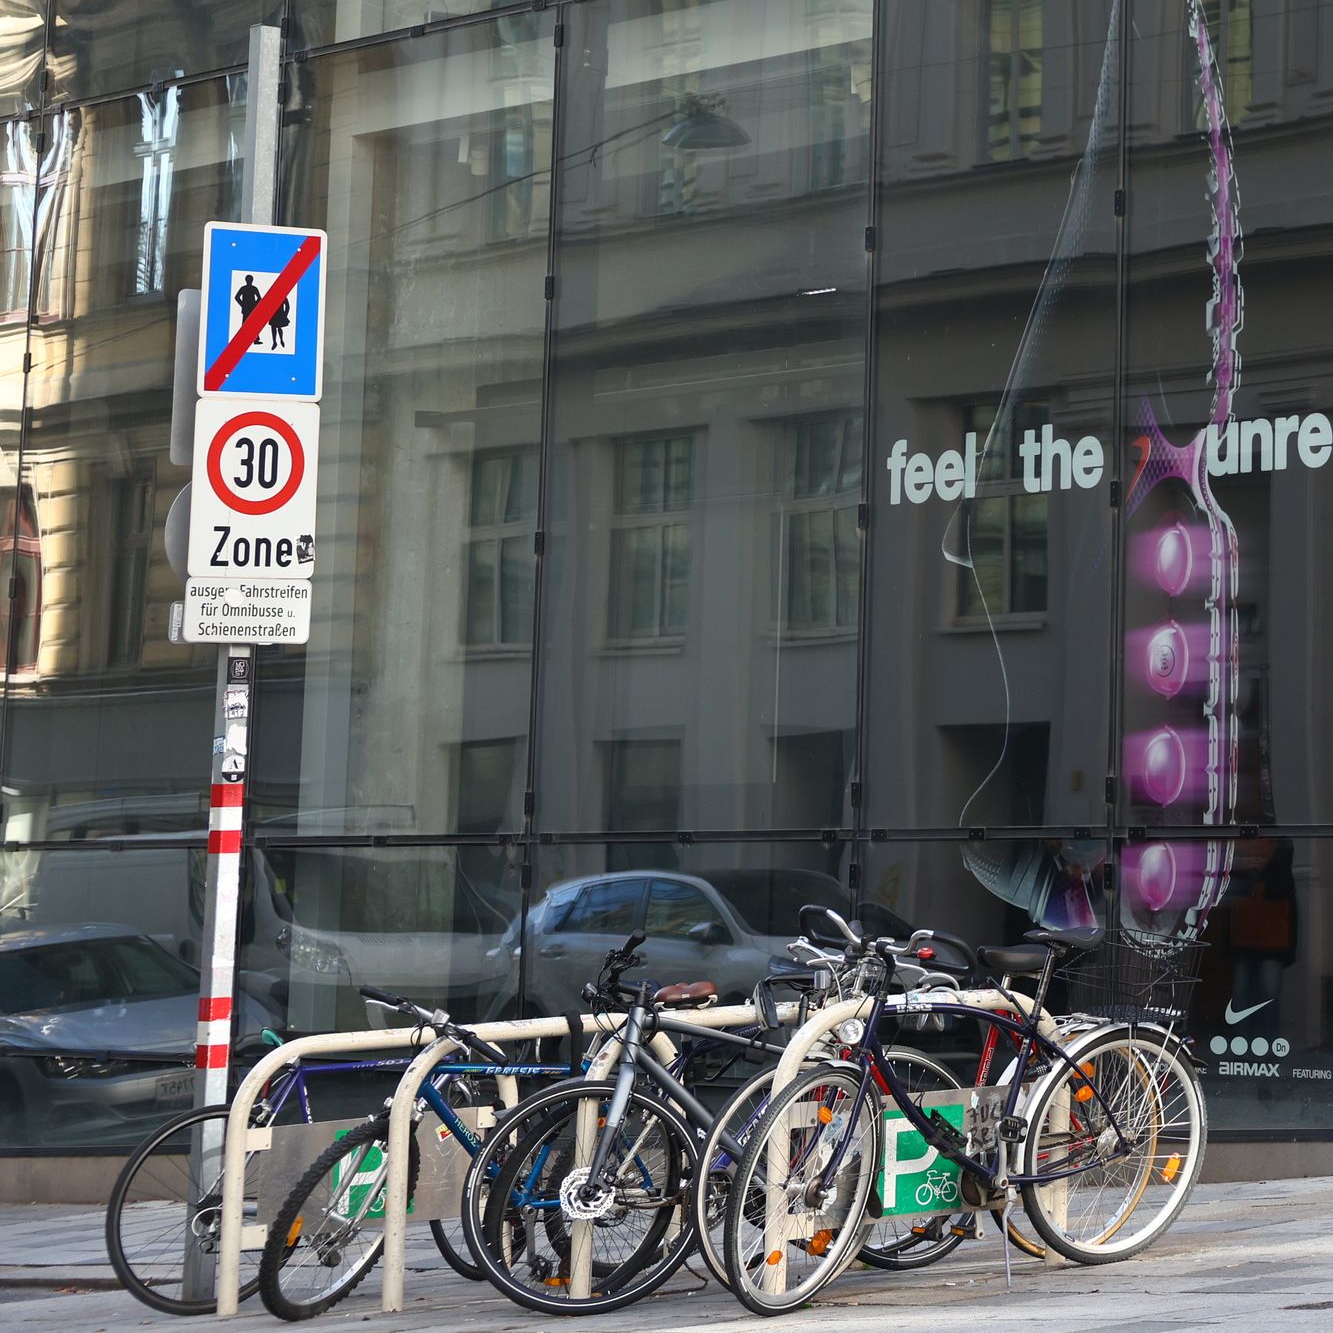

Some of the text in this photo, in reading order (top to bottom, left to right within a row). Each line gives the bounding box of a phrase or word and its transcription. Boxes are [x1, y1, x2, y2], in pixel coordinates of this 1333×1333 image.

[234, 438, 279, 489] 30
[887, 431, 976, 505] feel
[1019, 423, 1105, 494] the
[210, 526, 293, 567] Zone
[201, 603, 296, 618] für Omnibusse u.
[198, 622, 296, 637] Schienenstraßen
[1276, 1042, 1286, 1053] Dn
[1292, 1069, 1332, 1080] FEATURING
